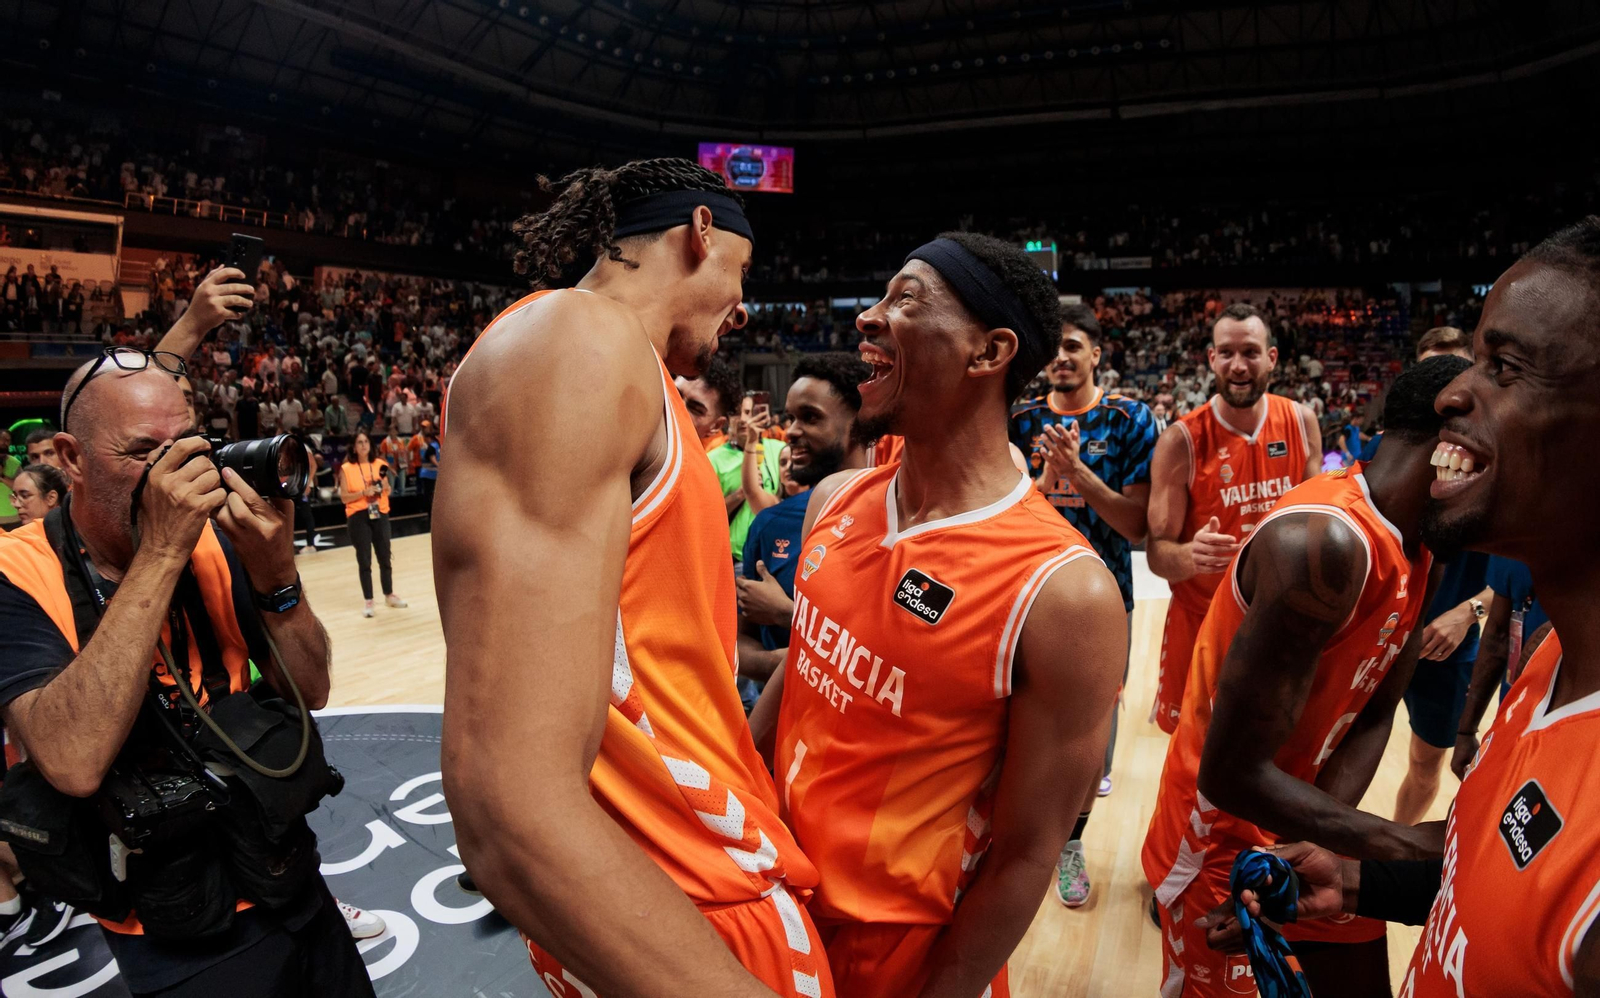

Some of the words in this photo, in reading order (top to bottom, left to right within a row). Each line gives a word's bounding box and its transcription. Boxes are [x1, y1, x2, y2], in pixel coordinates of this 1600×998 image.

[1220, 476, 1293, 508] VALENCIA
[1240, 499, 1277, 516] BASKET
[902, 578, 924, 598] liga
[897, 589, 939, 620] endesa
[791, 584, 906, 718] VALENCIA
[797, 647, 854, 715] BASKET
[1513, 795, 1532, 825] liga
[1503, 811, 1533, 863] endesa
